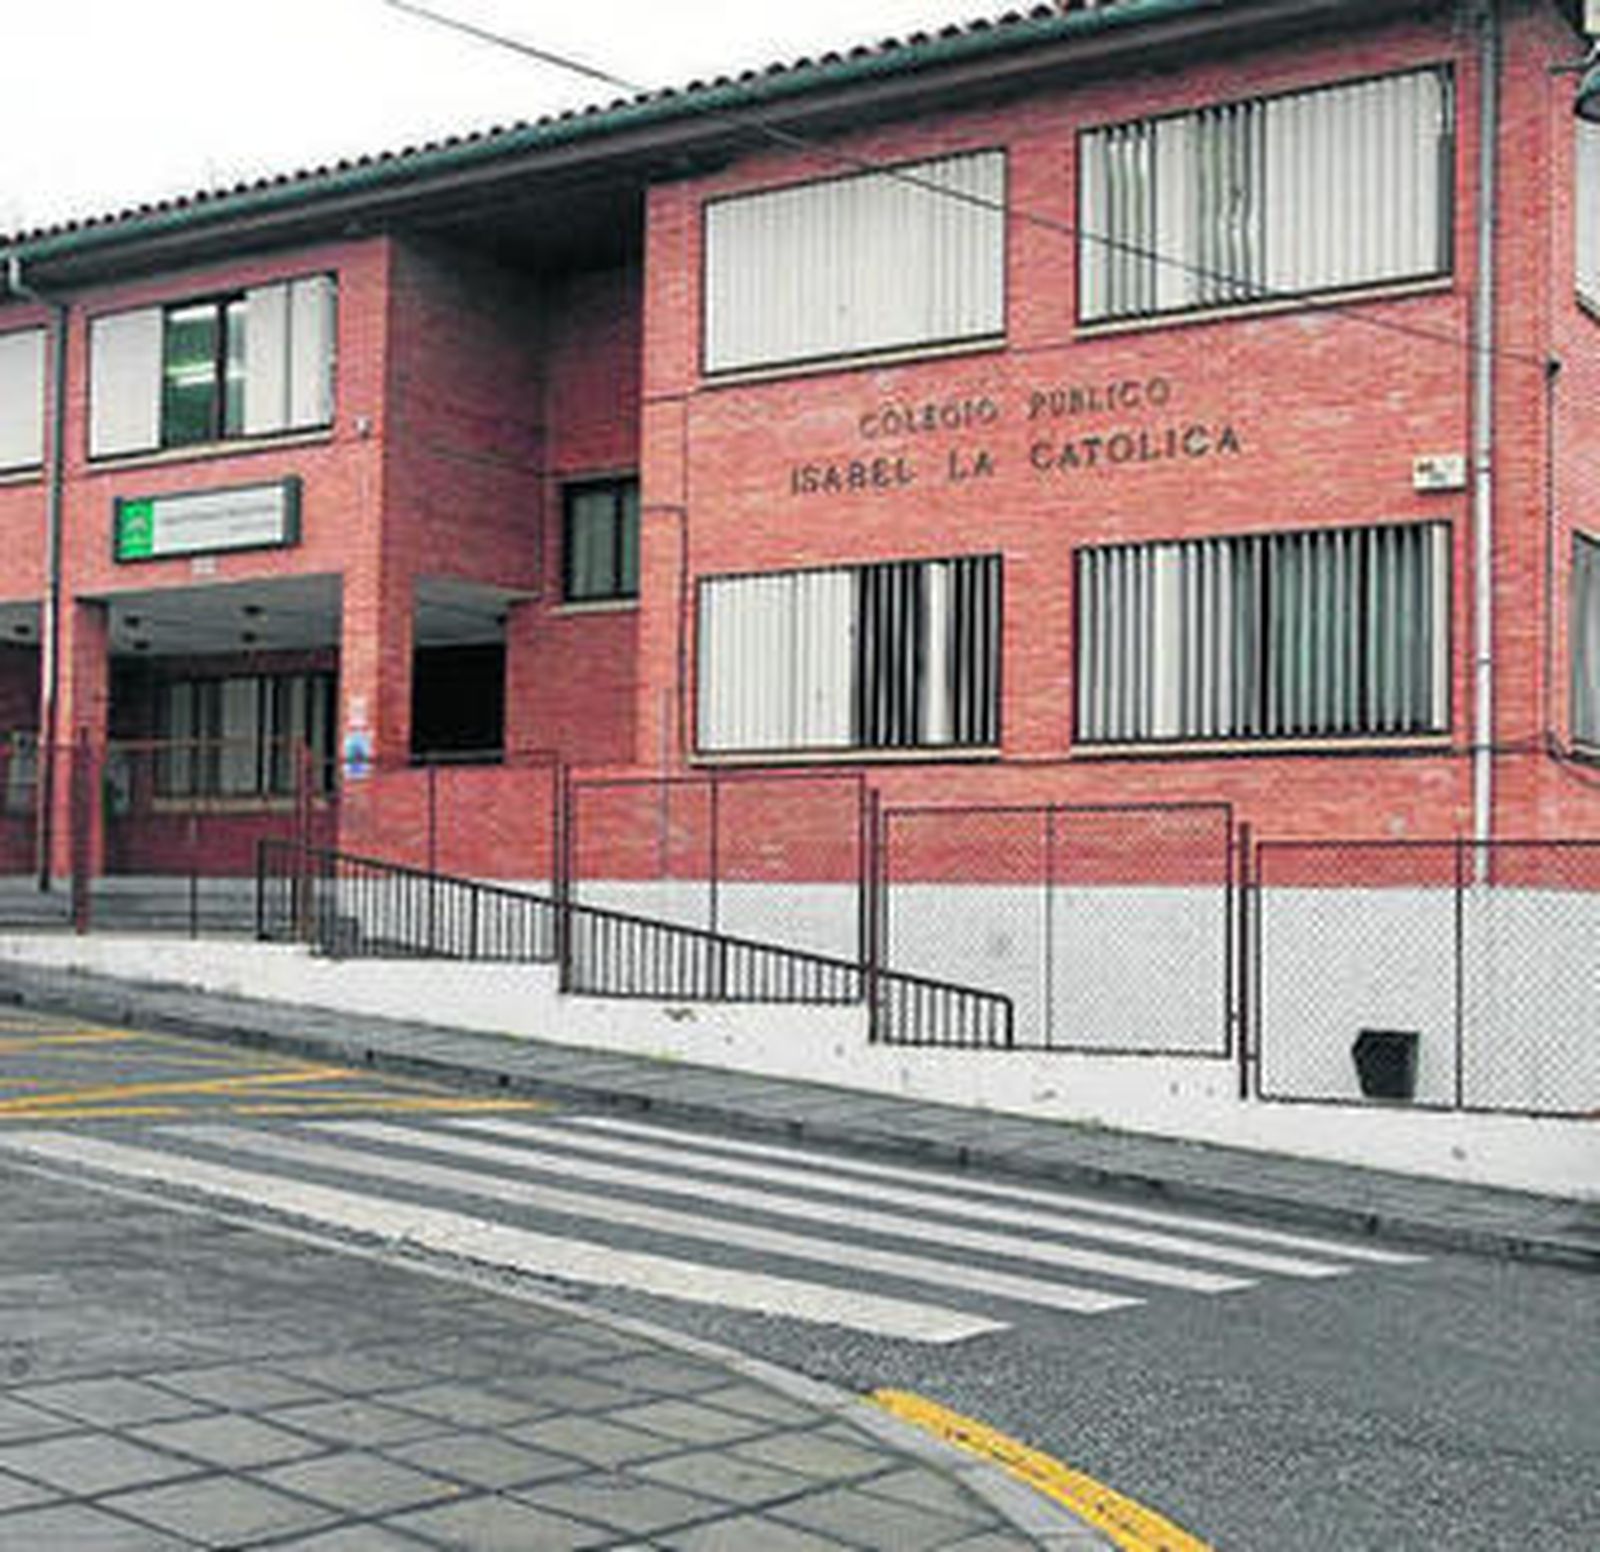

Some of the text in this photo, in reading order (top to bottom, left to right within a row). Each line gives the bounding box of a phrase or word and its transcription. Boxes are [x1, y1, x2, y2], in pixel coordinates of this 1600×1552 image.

[859, 377, 1171, 439] COLEGIO PUBLICO
[790, 424, 1241, 495] ISABEL LA CATOLICA
